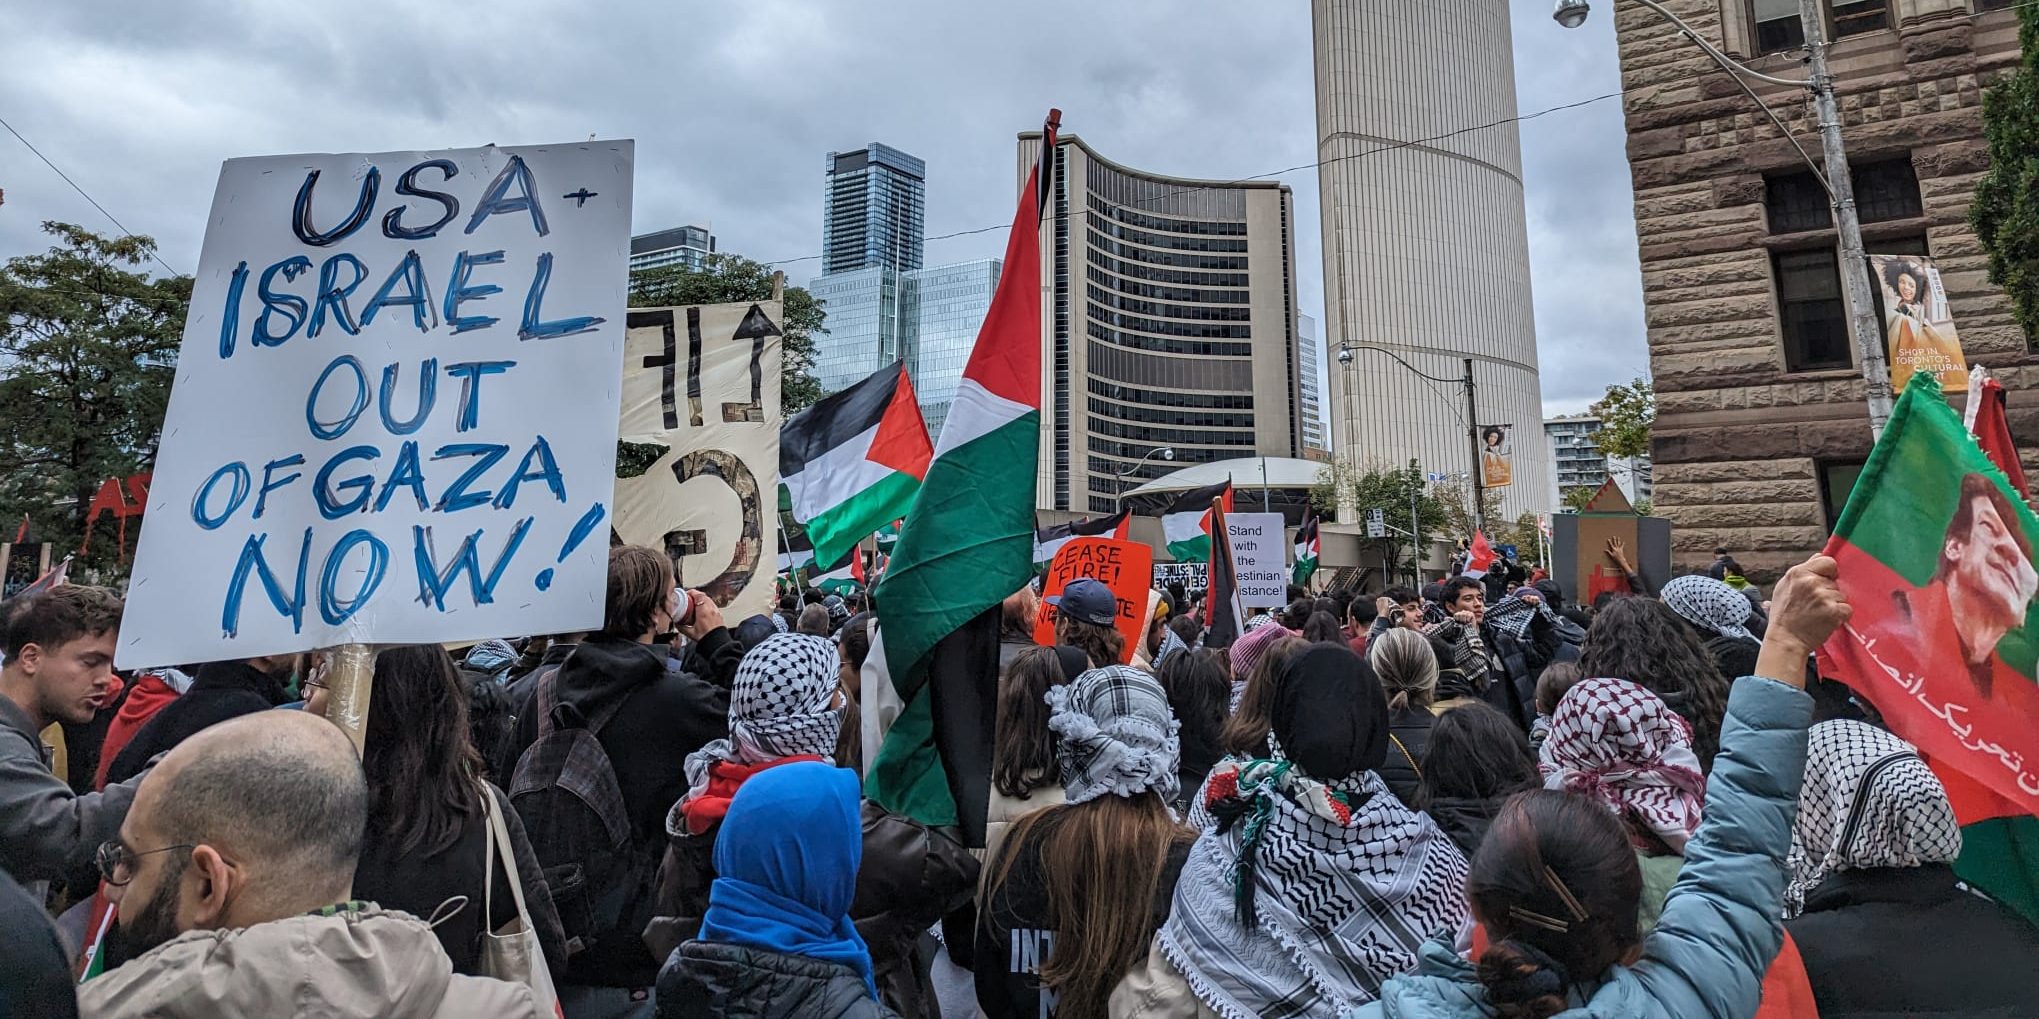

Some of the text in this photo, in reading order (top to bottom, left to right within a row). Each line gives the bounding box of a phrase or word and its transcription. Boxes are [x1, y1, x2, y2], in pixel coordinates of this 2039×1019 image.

[292, 154, 549, 247] USA
[220, 249, 607, 359] ISRAEL
[1898, 347, 1938, 356] SHOP IN
[1895, 355, 1951, 365] TORONTO'S
[1914, 363, 1965, 371] CULTURAL
[306, 354, 517, 440] OUT
[190, 435, 568, 530] OF GAZA
[1228, 525, 1262, 536] Stand
[1234, 540, 1257, 551] with
[1053, 544, 1122, 572] CEASE
[1237, 555, 1256, 566] the
[221, 503, 607, 639] NOW!
[1058, 562, 1121, 587] FIRE!
[1236, 570, 1280, 580] estinian
[1239, 586, 1283, 596] istance!
